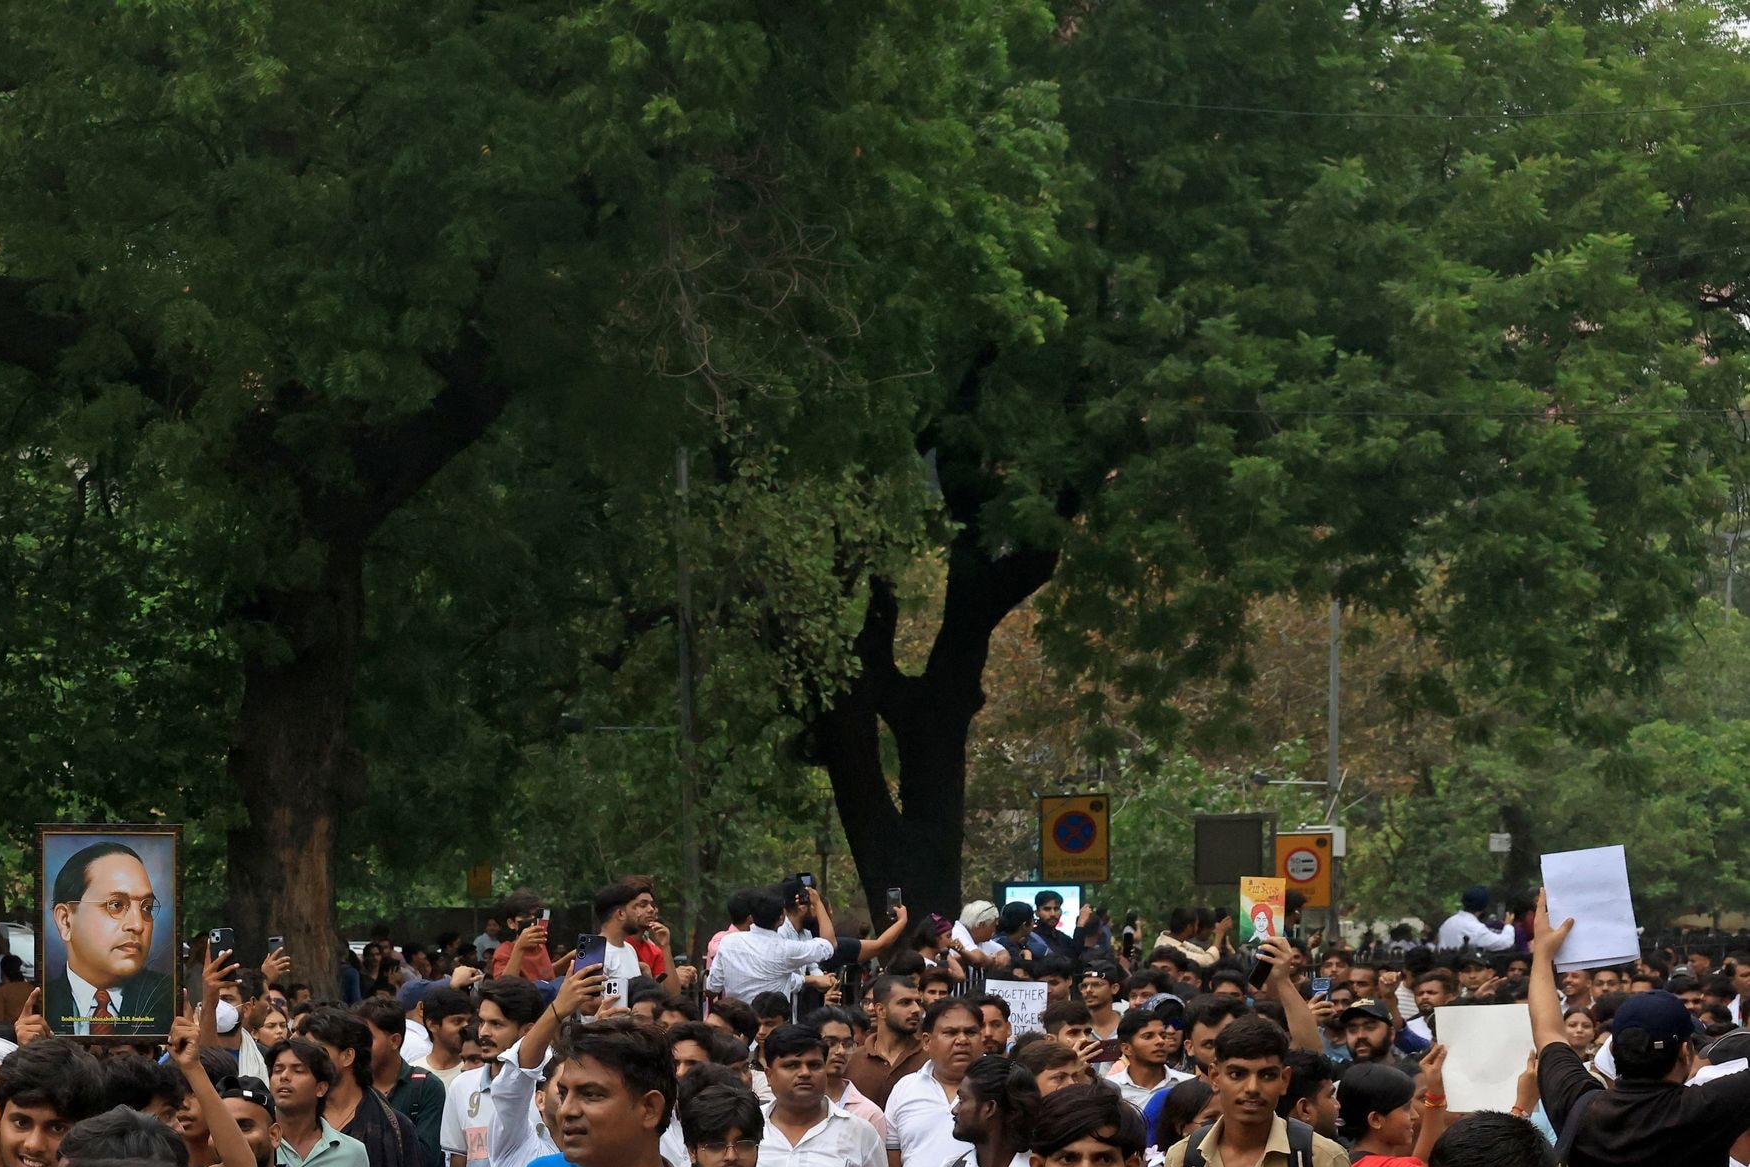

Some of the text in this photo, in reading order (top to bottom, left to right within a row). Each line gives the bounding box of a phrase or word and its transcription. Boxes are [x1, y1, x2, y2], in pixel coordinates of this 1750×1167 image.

[990, 988, 1046, 1001] TOGETHER
[1021, 1002, 1027, 1011] A
[1010, 1012, 1043, 1025] ONGER
[467, 1091, 481, 1118] 9
